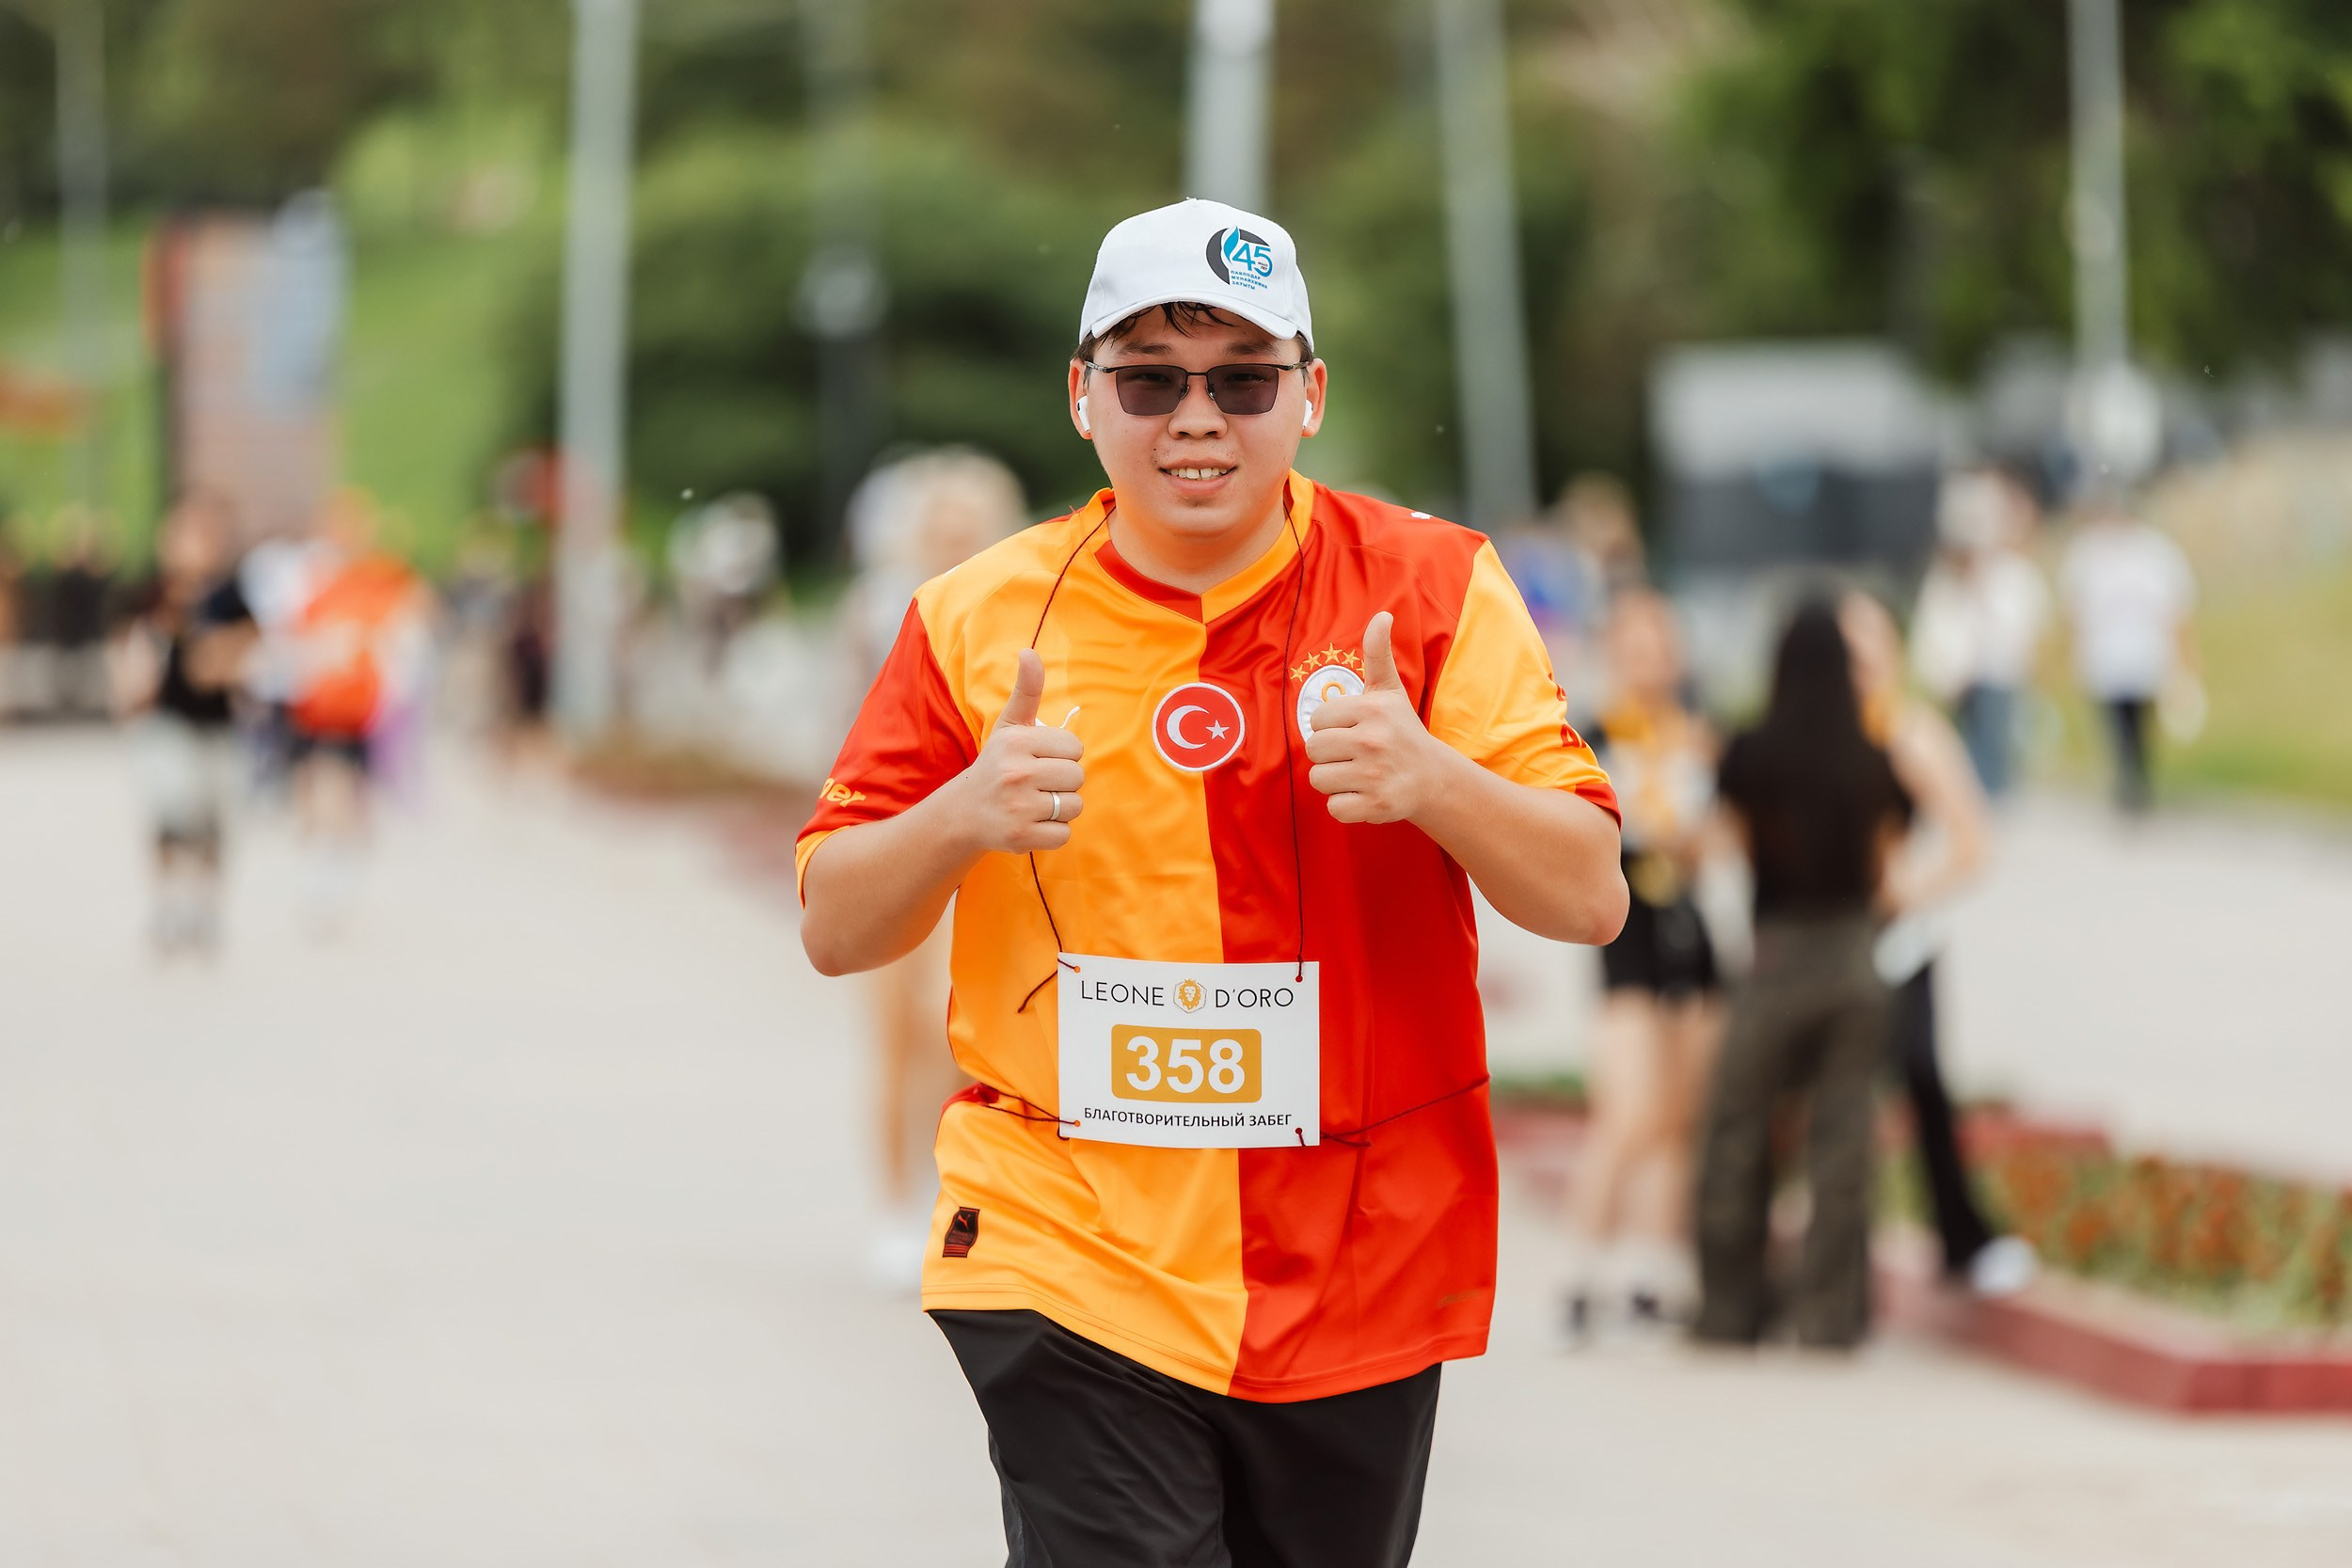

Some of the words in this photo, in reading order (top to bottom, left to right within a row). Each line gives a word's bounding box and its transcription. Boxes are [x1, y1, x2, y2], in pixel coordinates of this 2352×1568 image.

[1232, 243, 1273, 277] 45
[1081, 980, 1165, 1006] LEONE
[1215, 988, 1295, 1008] D'ORO
[1126, 1037, 1246, 1094] 358
[1084, 1107, 1245, 1128] БЛАГОТВОРИТЕЛЬНЫЙ
[1249, 1114, 1293, 1127] ЗАБЕГ
